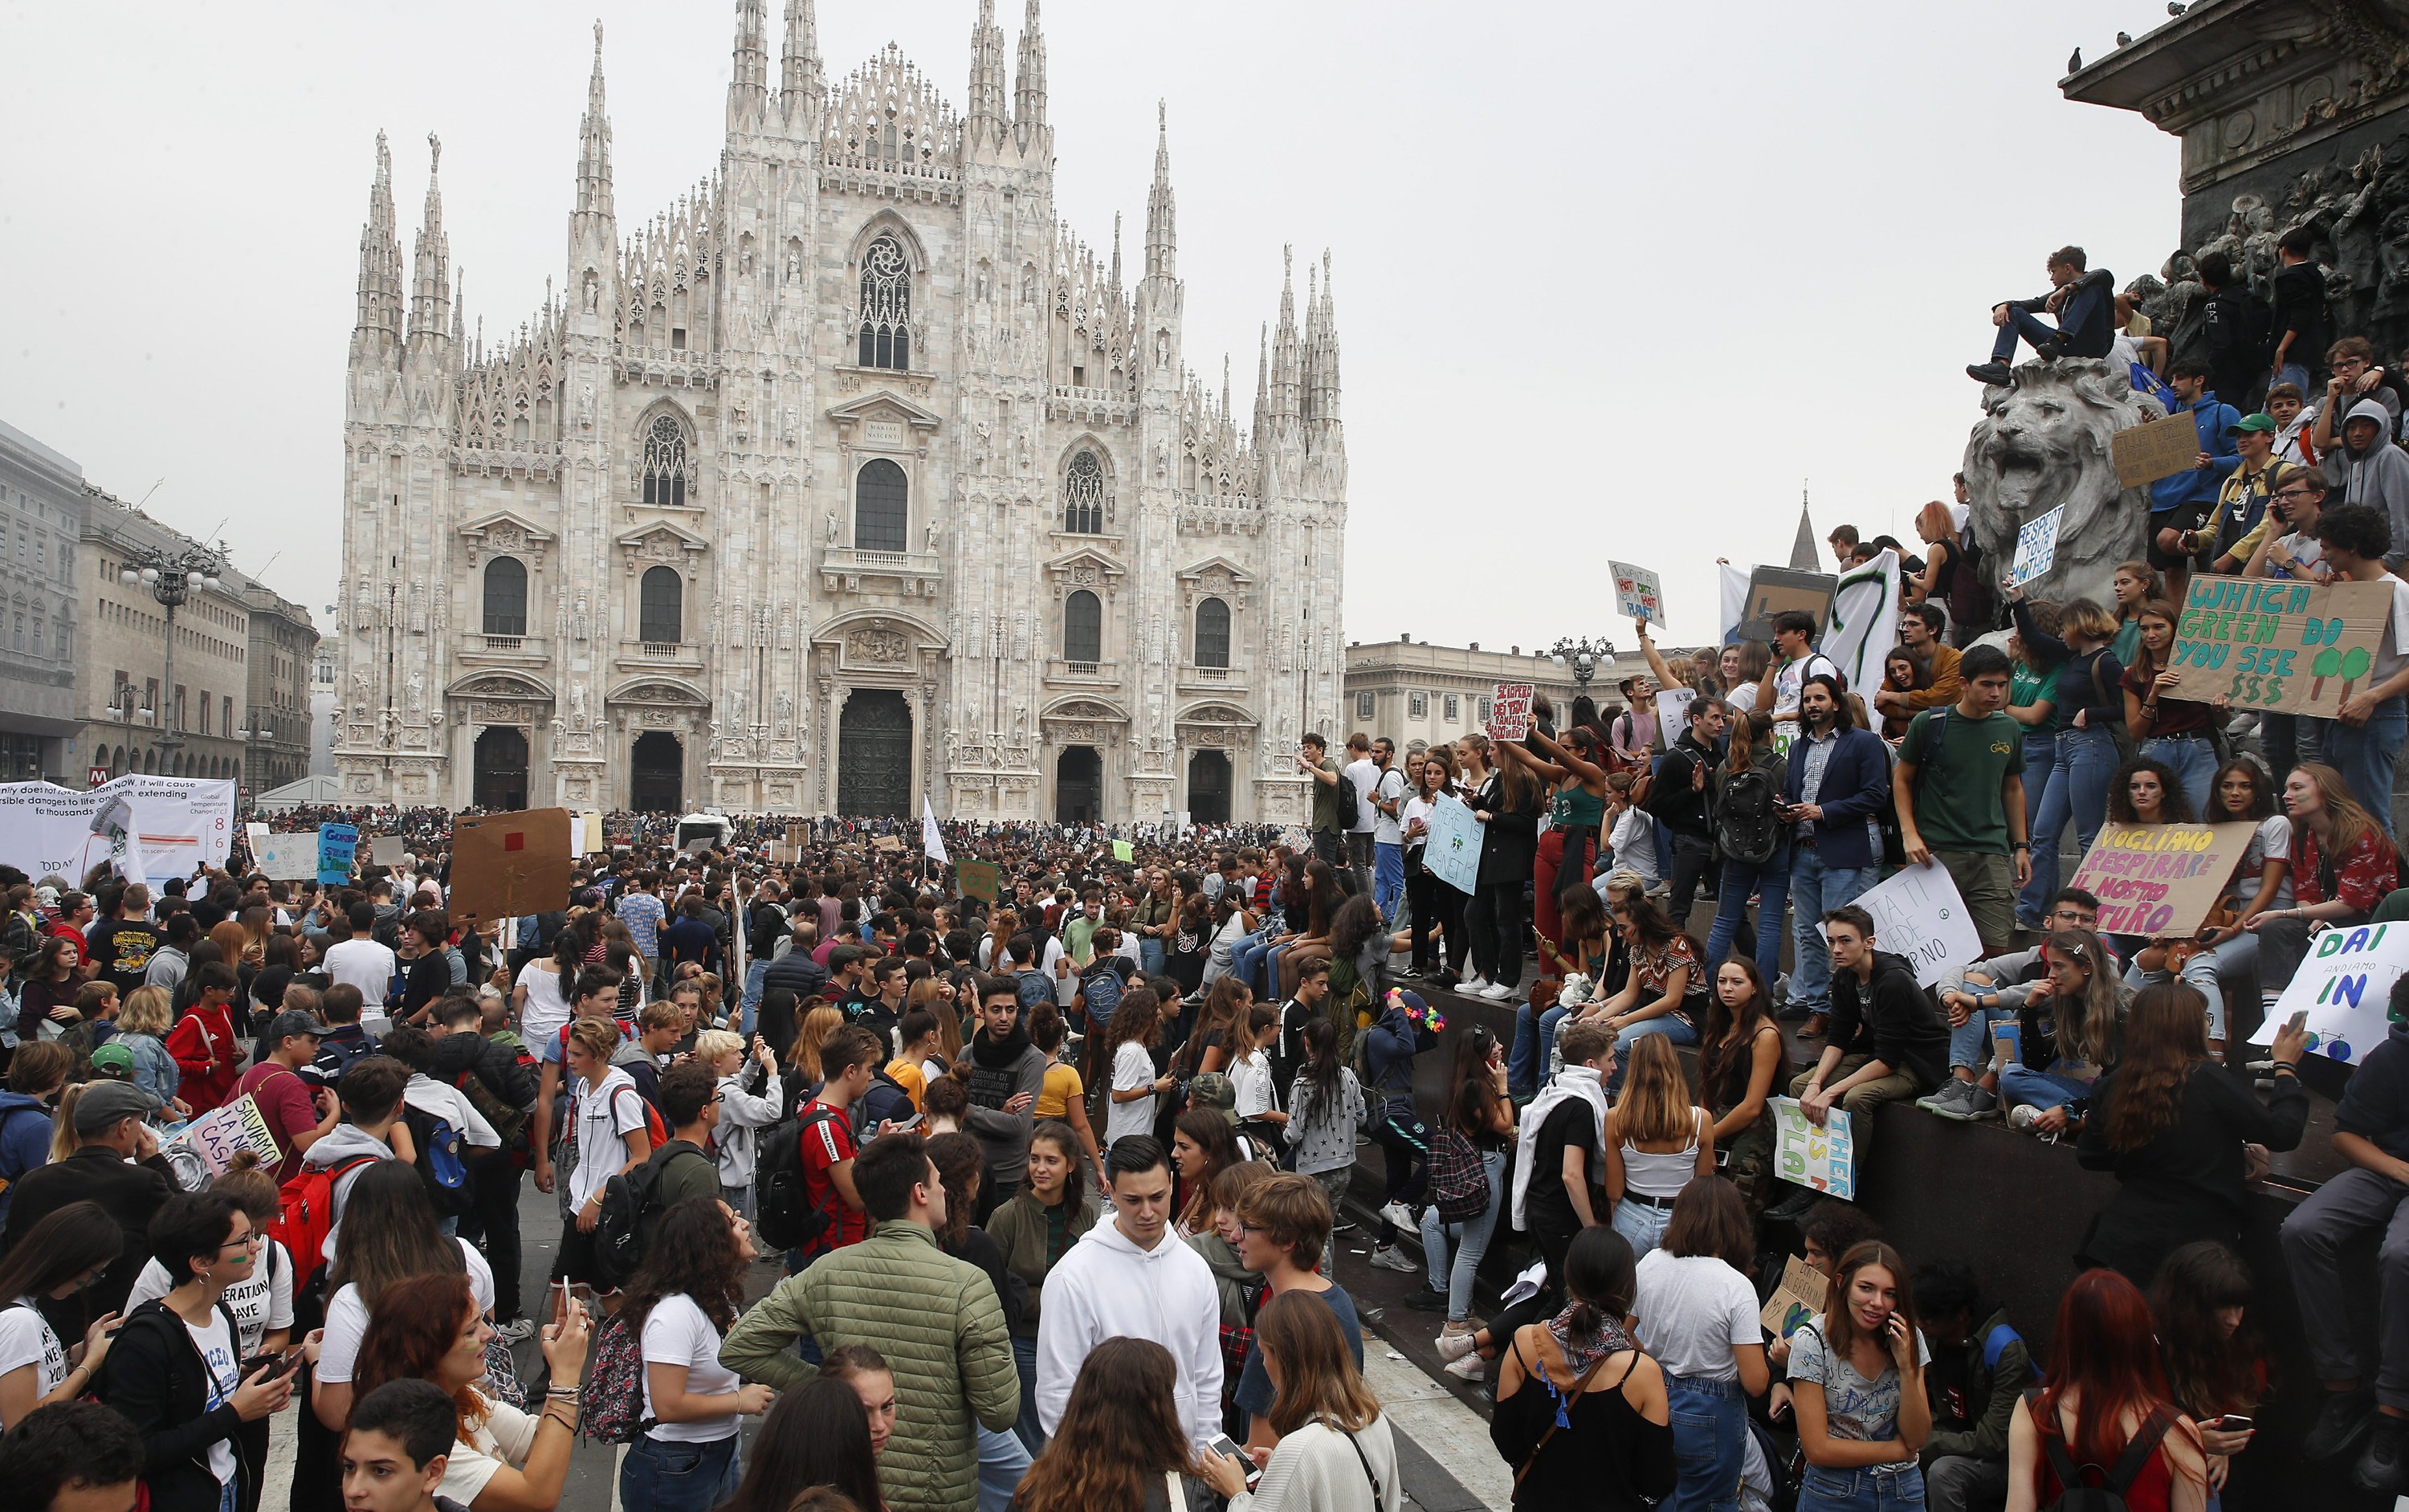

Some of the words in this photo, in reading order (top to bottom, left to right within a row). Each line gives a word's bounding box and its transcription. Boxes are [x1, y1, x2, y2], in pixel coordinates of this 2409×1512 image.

[2206, 302, 2218, 324] EA7
[2016, 506, 2064, 548] RESPECT
[2025, 533, 2050, 560] YOUR
[1612, 564, 1623, 577] I
[1621, 567, 1643, 581] WANT
[1645, 574, 1653, 585] A
[1618, 579, 1633, 592] HOT
[1619, 593, 1630, 601] NOT
[1633, 593, 1640, 602] A
[1641, 594, 1656, 608] HOT
[2189, 579, 2311, 614] WHICH
[1626, 601, 1653, 621] PLANET
[2179, 609, 2281, 644] GREEN
[2301, 617, 2344, 646] DO
[2173, 640, 2231, 670] YOU
[2236, 646, 2297, 677] SEE
[1780, 724, 1794, 734] THE
[0, 787, 18, 795] nity
[114, 779, 137, 792] NOW,
[140, 779, 147, 787] it
[90, 770, 108, 783] M
[80, 797, 96, 805] life
[98, 795, 111, 803] on
[114, 789, 136, 797] arth,
[138, 790, 188, 800] extending
[239, 787, 249, 795] M
[47, 808, 94, 817] thousands
[214, 817, 224, 830] 8
[1436, 798, 1464, 833] THERE
[1469, 821, 1482, 842] IS
[215, 838, 224, 848] 6
[259, 834, 280, 846] ONE
[283, 834, 297, 844] DAY
[40, 858, 75, 871] TODAY
[215, 854, 222, 865] 4
[1426, 841, 1464, 882] PLANET
[1461, 849, 1478, 886] B
[1898, 875, 1930, 907] TI
[2093, 876, 2169, 903] NOSTRO
[2095, 902, 2175, 934] TURO
[1920, 938, 1946, 966] NO
[2316, 923, 2387, 959] DAI
[2323, 961, 2377, 975] ANDIAMO
[2316, 973, 2367, 1009] IN
[1255, 1080, 1269, 1113] SINCE
[217, 1110, 238, 1134] LA
[234, 1099, 277, 1164] SALVIAMO
[222, 1279, 269, 1302] ERATION
[1782, 1270, 1794, 1289] GO
[1792, 1277, 1825, 1310] BREAKING
[233, 1302, 259, 1320] AVE
[1766, 1298, 1785, 1322] MY
[240, 1320, 263, 1335] NET
[205, 1347, 230, 1368] CEO
